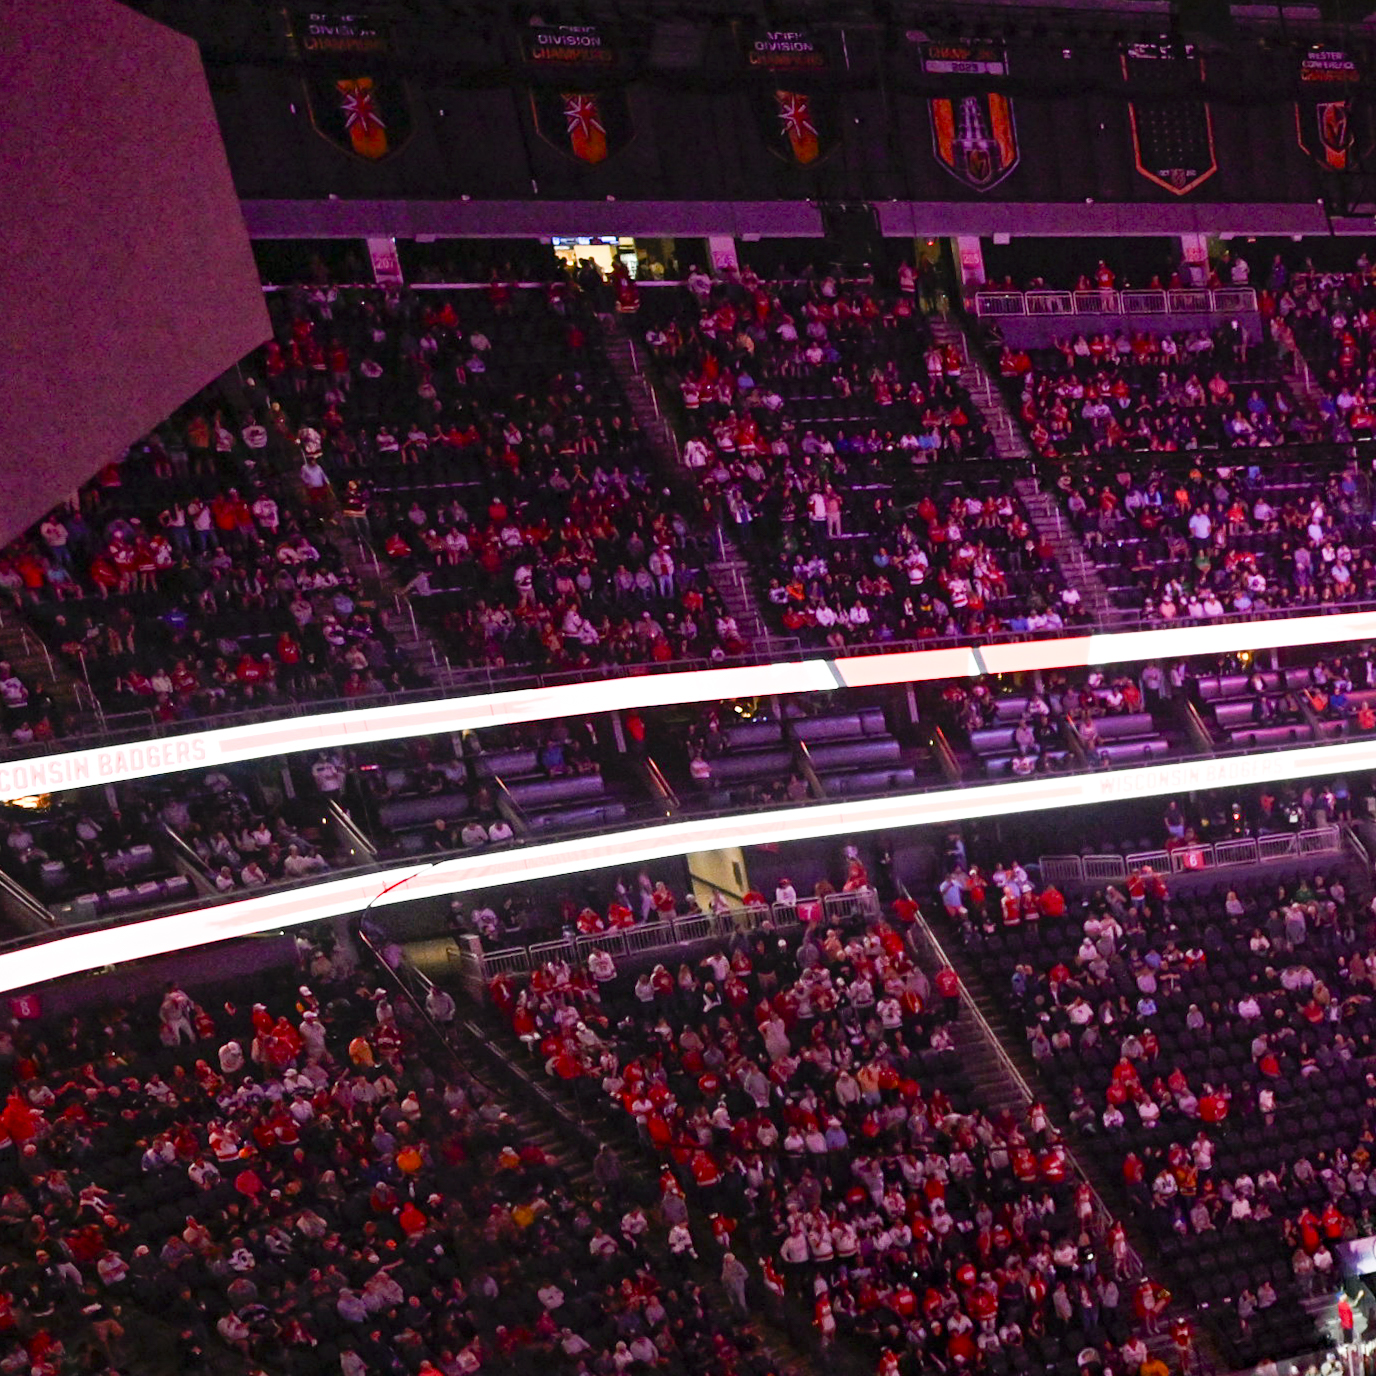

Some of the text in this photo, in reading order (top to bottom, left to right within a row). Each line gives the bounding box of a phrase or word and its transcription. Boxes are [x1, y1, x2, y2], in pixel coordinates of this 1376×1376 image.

[100, 738, 206, 778] BADGERS
[1100, 757, 1283, 794] WISCONSIN BADGERS
